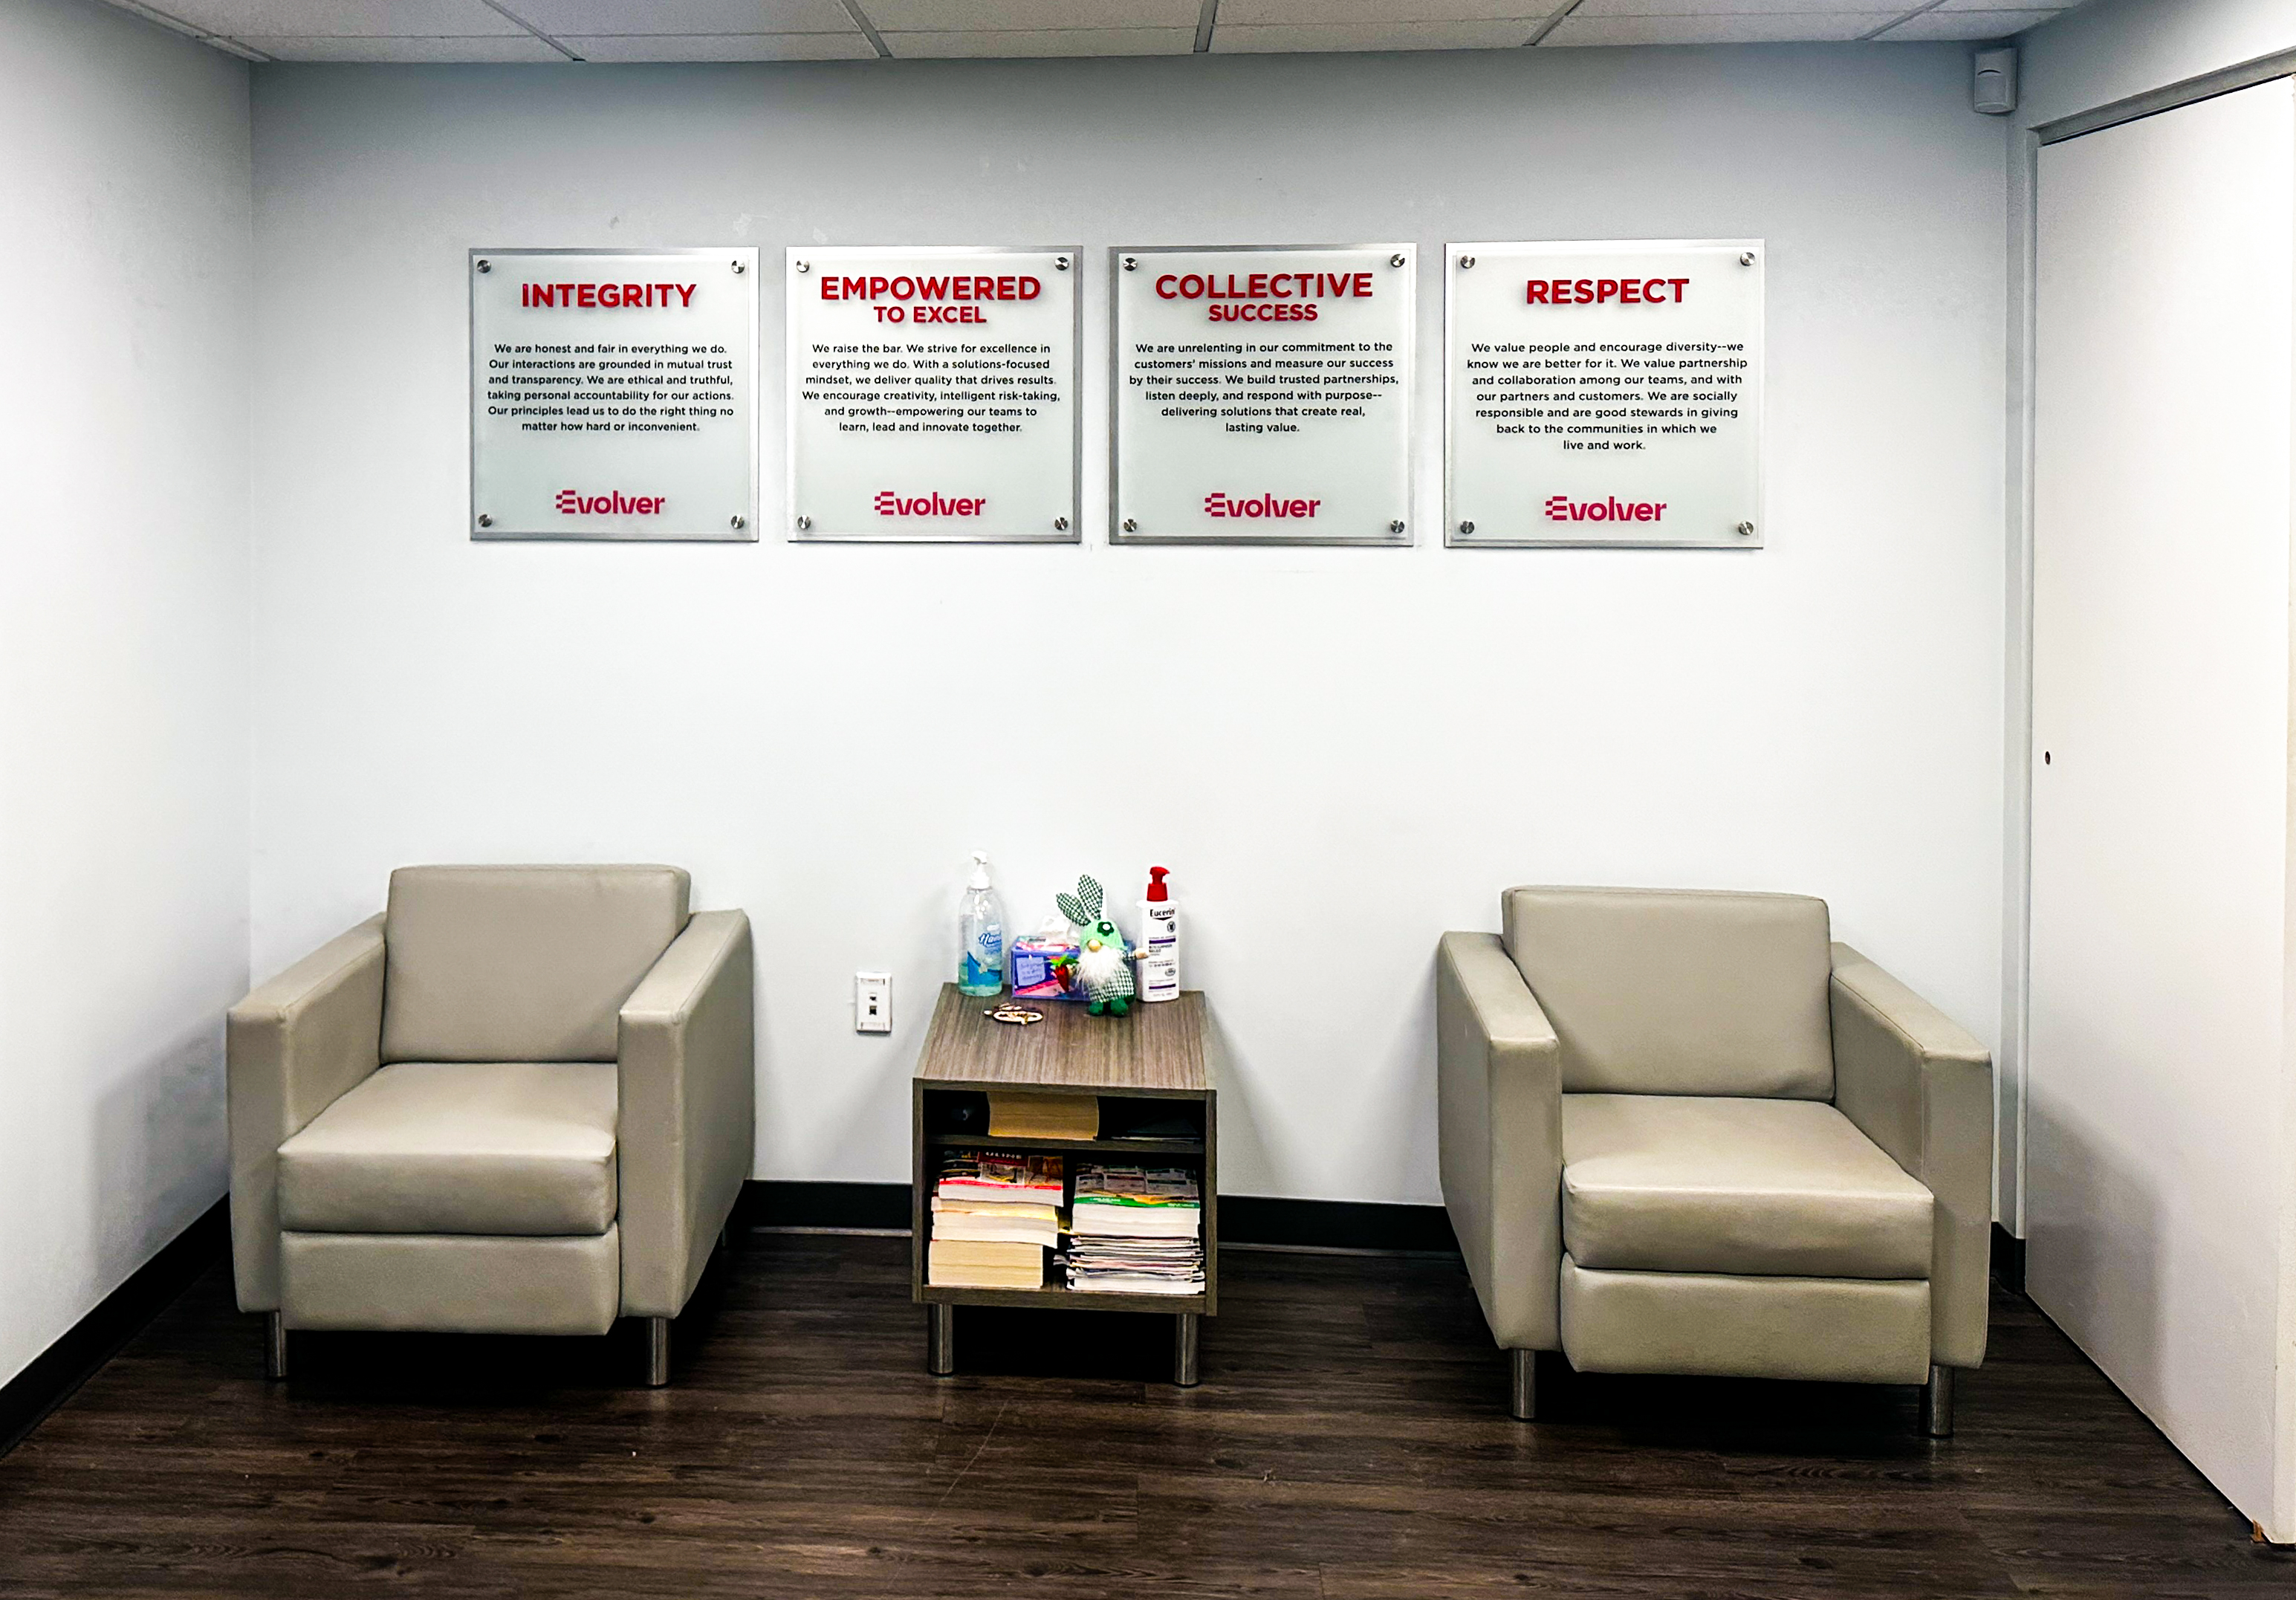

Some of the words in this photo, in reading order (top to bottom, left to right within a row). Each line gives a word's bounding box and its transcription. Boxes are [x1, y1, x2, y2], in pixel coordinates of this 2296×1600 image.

[821, 276, 1041, 300] EMPOWERED
[1155, 273, 1372, 299] COLLECTIVE
[1527, 279, 1689, 304] RESPECT
[522, 283, 695, 308] INTEGRITY
[874, 306, 904, 323] TO
[913, 306, 986, 323] EXCEL
[1209, 303, 1317, 321] SUCCESS
[494, 344, 512, 353] We
[535, 344, 571, 354] honest
[574, 344, 594, 353] and
[598, 344, 615, 353] fair
[619, 344, 628, 353] in
[632, 344, 688, 354] everything
[710, 344, 727, 353] do.
[812, 344, 829, 352] We
[834, 344, 858, 353] raise
[862, 344, 879, 353] the
[883, 344, 903, 353] bar.
[907, 344, 924, 353] We
[927, 344, 957, 353] strive
[961, 344, 976, 353] for
[980, 343, 1037, 353] excellence
[1041, 344, 1050, 353] in
[1135, 344, 1154, 353] We
[1178, 343, 1242, 354] unrelenting
[1246, 343, 1256, 352] in
[1282, 343, 1355, 353] commitment
[1359, 343, 1370, 352] to
[1374, 342, 1392, 351] the
[1471, 343, 1491, 352] We
[1494, 343, 1525, 352] value
[1529, 343, 1570, 354] people
[1574, 343, 1595, 352] and
[1600, 344, 1662, 353] encourage
[489, 359, 510, 369] Our
[513, 359, 575, 369] interactions
[599, 360, 651, 370] grounded
[655, 360, 664, 369] in
[667, 360, 704, 369] mutual
[707, 360, 733, 369] trust
[813, 360, 870, 370] everything
[892, 360, 909, 369] do.
[913, 360, 938, 369] With
[952, 360, 1049, 369] solutions-focused
[1199, 359, 1247, 369] missions
[1251, 358, 1271, 368] and
[1275, 360, 1323, 370] measure
[1467, 360, 1499, 369] know
[1545, 359, 1581, 368] better
[1585, 359, 1602, 368] for
[1606, 358, 1617, 368] it.
[1621, 359, 1640, 368] We
[1644, 358, 1675, 368] value
[1679, 358, 1747, 369] partnership
[806, 375, 852, 385] mindset,
[875, 375, 912, 384] deliver
[915, 375, 952, 386] quality
[956, 375, 977, 384] that
[981, 375, 1014, 385] drives
[1017, 375, 1057, 384] results.
[1129, 375, 1144, 386] by
[1147, 375, 1173, 387] their
[1225, 375, 1245, 386] We
[1248, 375, 1276, 386] build
[1279, 375, 1320, 384] trusted
[1323, 374, 1398, 386] partnerships,
[1472, 375, 1494, 385] and
[1498, 375, 1575, 385] collaboration
[1579, 377, 1621, 386] among
[1648, 375, 1687, 386] teams,
[1690, 375, 1713, 384] and
[1716, 375, 1742, 384] with
[487, 390, 521, 401] taking
[524, 390, 571, 401] personal
[574, 390, 649, 401] accountability
[652, 391, 668, 400] for
[693, 391, 734, 400] actions.
[802, 391, 820, 400] We
[823, 392, 880, 401] encourage
[884, 391, 937, 402] creativity,
[941, 391, 996, 402] intelligent
[999, 391, 1060, 402] risk-taking,
[1500, 392, 1549, 403] partners
[1553, 392, 1575, 401] and
[1579, 392, 1644, 401] customers.
[1647, 392, 1667, 401] We
[1693, 391, 1737, 402] socially
[488, 406, 508, 415] Our
[511, 406, 563, 417] principles
[566, 406, 589, 415] lead
[608, 407, 619, 415] to
[622, 406, 636, 415] do
[640, 407, 657, 415] the
[661, 407, 686, 417] right
[689, 407, 716, 418] thing
[825, 407, 844, 415] and
[989, 407, 1022, 416] teams
[1025, 407, 1037, 416] to
[1161, 407, 1217, 418] delivering
[1221, 407, 1271, 416] solutions
[1274, 407, 1298, 416] that
[1302, 407, 1337, 416] create
[1341, 407, 1365, 417] real,
[1476, 407, 1543, 419] responsible
[1547, 408, 1569, 417] and
[1595, 407, 1627, 418] good
[1630, 407, 1683, 417] stewards
[1687, 407, 1697, 417] in
[1702, 407, 1738, 418] giving
[1226, 422, 1263, 433] lasting
[1267, 423, 1300, 432] value.
[1496, 424, 1525, 433] back
[1528, 425, 1540, 433] to
[1544, 424, 1563, 433] the
[1567, 424, 1644, 433] communities
[1647, 424, 1657, 433] in
[1661, 424, 1696, 433] which
[1563, 440, 1583, 450] live
[1587, 440, 1609, 450] and
[1613, 441, 1646, 450] work.
[556, 490, 665, 514] Evolver
[875, 491, 985, 516] Evolver
[1204, 493, 1320, 517] Evolver
[1546, 496, 1667, 521] Evolver
